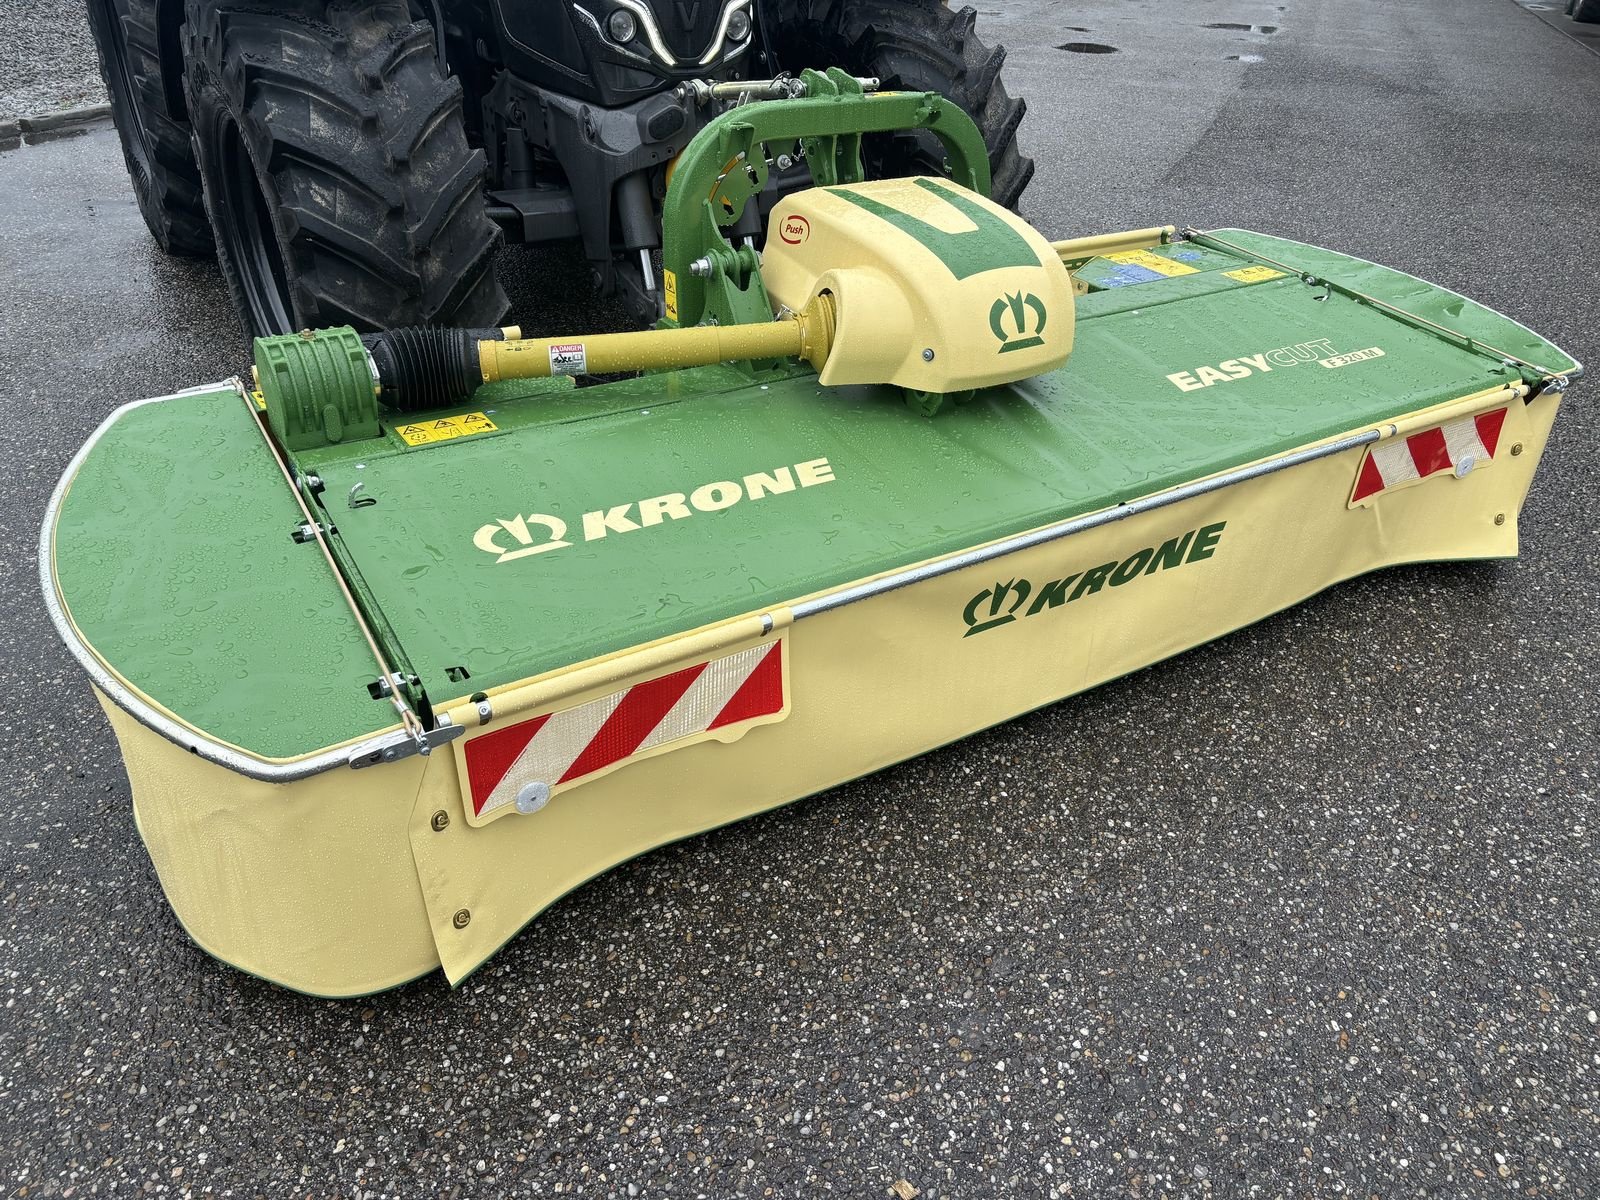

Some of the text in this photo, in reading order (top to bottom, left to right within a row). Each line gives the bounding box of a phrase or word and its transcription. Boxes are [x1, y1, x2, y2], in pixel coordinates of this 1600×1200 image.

[785, 224, 804, 235] Push
[1336, 351, 1363, 365] 320
[1361, 349, 1379, 358] M
[582, 457, 836, 542] KRONE
[1025, 520, 1228, 617] KRONE
